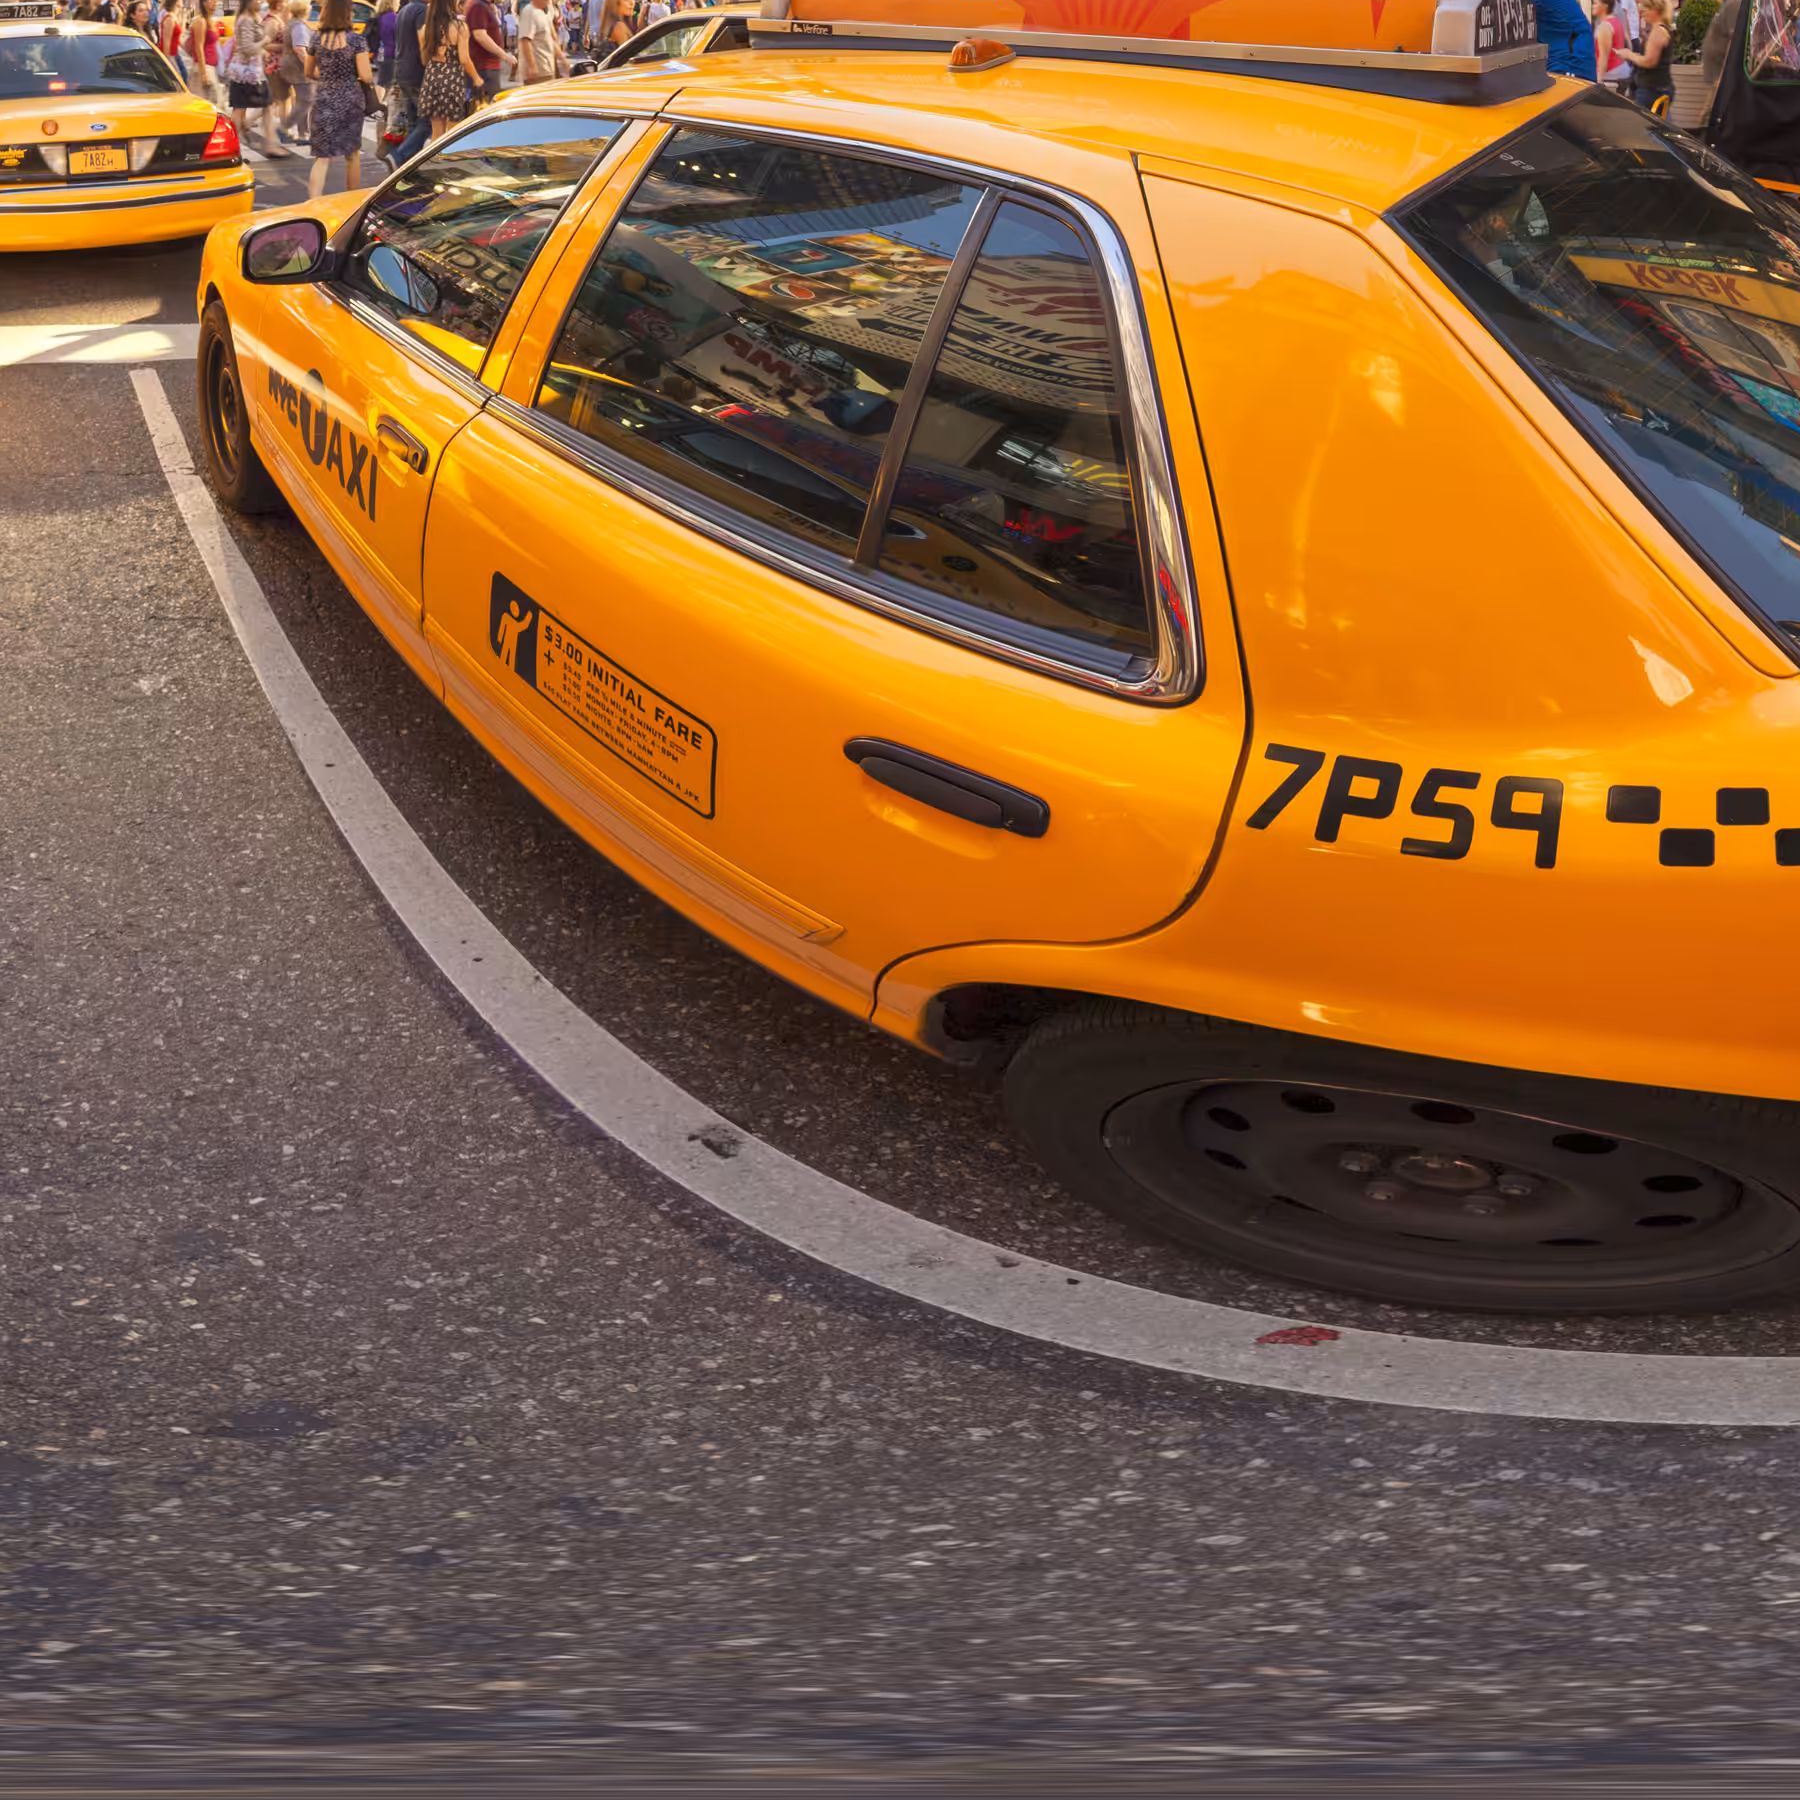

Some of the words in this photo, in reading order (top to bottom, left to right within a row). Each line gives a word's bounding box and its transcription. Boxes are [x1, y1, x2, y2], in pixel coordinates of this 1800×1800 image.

[13, 5, 39, 18] 7A82
[542, 623, 584, 668] $3.00
[587, 653, 646, 716] INITIAL
[654, 702, 704, 752] FARE
[1246, 740, 1566, 874] 7P59
